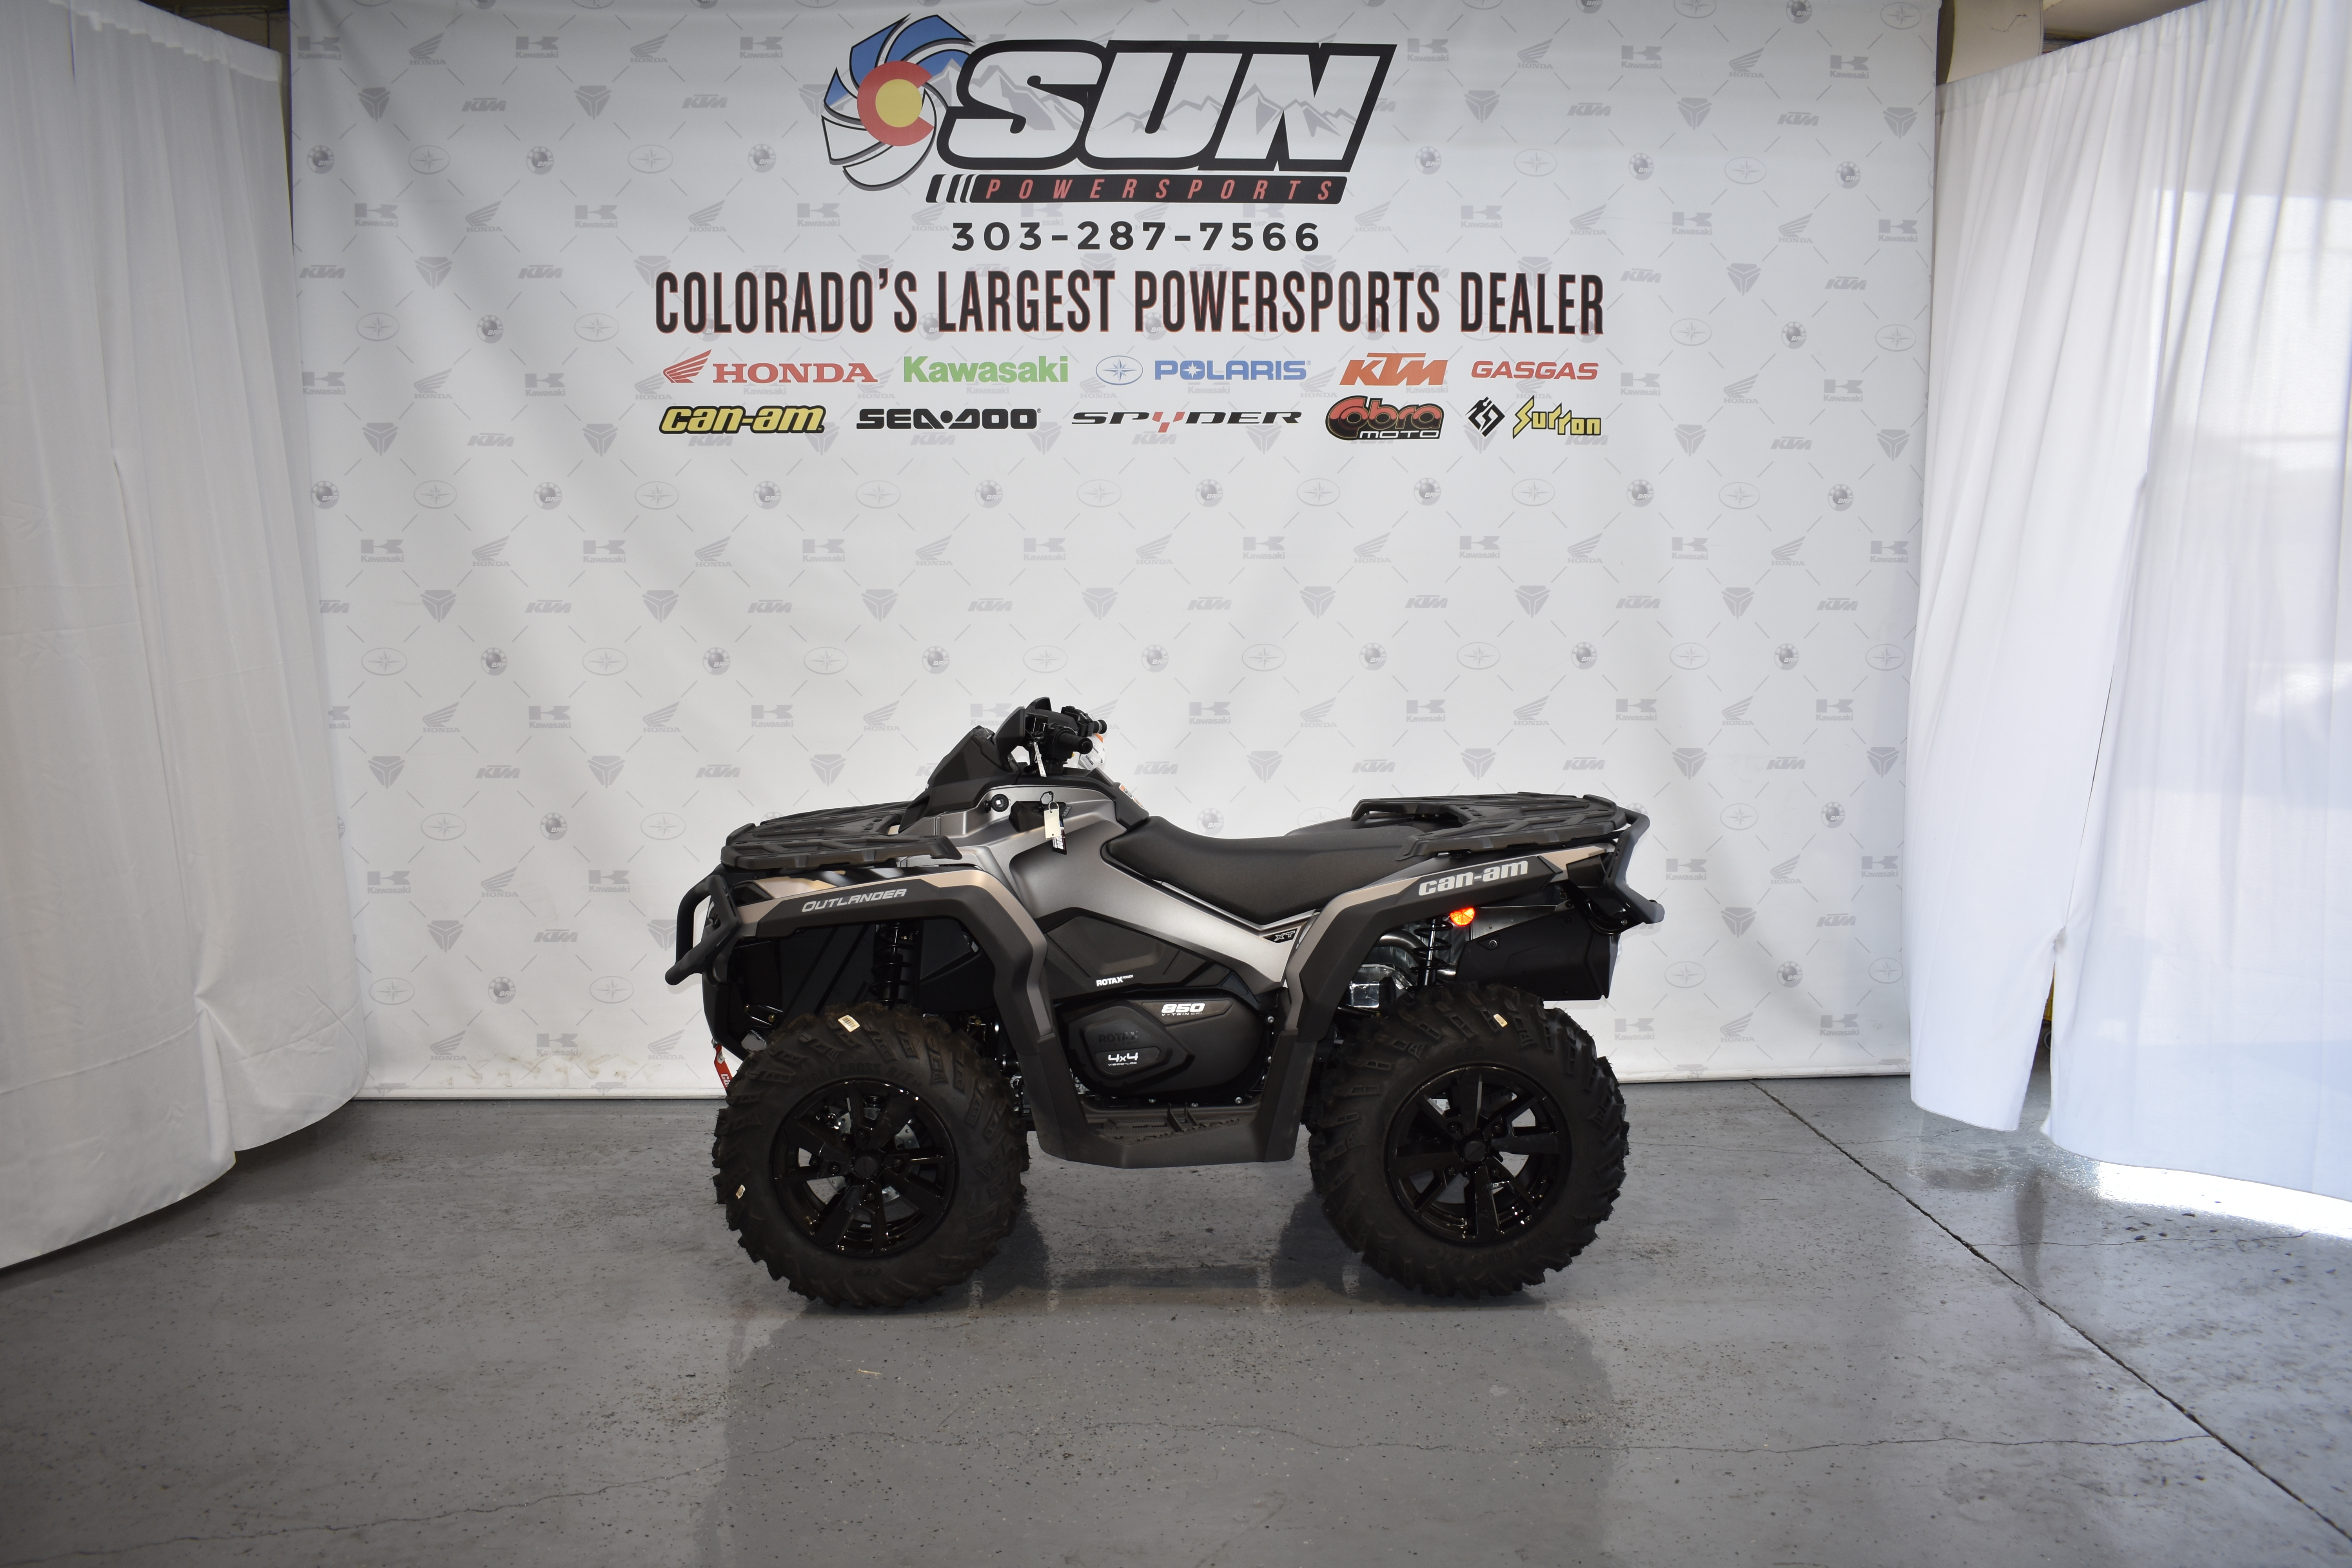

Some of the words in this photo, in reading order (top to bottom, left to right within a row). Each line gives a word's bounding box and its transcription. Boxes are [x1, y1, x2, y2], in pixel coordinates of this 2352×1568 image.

[461, 98, 506, 112] KTM
[682, 94, 728, 109] KTM
[937, 40, 1397, 172] SUN
[1567, 102, 1612, 116] KTM
[1777, 112, 1820, 125] KTM
[986, 178, 1332, 200] POWERSPORTS
[952, 221, 1318, 251] 303-287-7566
[299, 264, 346, 279] KTM
[517, 265, 563, 279] KTM
[1620, 269, 1662, 282] KTM
[1824, 276, 1867, 290] KTM
[938, 269, 1115, 332] LARGEST
[1135, 270, 1439, 333] POWERSPORTS
[1461, 272, 1604, 334] DEALER
[713, 363, 878, 383] HONDA
[904, 356, 1069, 383] Kawasaki
[1339, 353, 1448, 386] KTM
[1472, 361, 1599, 380] GASGAS
[744, 387, 786, 395] Kawasaki
[659, 406, 826, 434] can-am
[1072, 412, 1302, 433] SPYDER
[467, 432, 515, 447] KTM
[910, 432, 955, 446] KTM
[1132, 430, 1177, 445] KTM
[1359, 430, 1439, 439] MOTO
[1770, 437, 1813, 450] KTM
[525, 599, 572, 614] KTM
[747, 599, 792, 613] KTM
[967, 598, 1013, 612] KTM
[1187, 597, 1232, 610] KTM
[1405, 595, 1448, 608] KTM
[1615, 595, 1661, 609] KTM
[1816, 598, 1858, 611] KTM
[1134, 761, 1178, 775] KTM
[1352, 759, 1395, 773] KTM
[1563, 757, 1605, 770] KTM
[1766, 757, 1806, 769] KTM
[475, 765, 520, 779] KTM
[695, 764, 740, 778] KTM
[1418, 860, 1528, 896] can-am
[802, 888, 907, 912] OUTLANDER
[1816, 914, 1857, 926] KTM
[534, 929, 578, 943] KTM
[1274, 931, 1295, 941] XT
[1096, 976, 1123, 986] ROTAX
[1161, 1003, 1205, 1013] 850
[1098, 1031, 1138, 1043] ROTAX
[1108, 1052, 1138, 1062] 4x4
